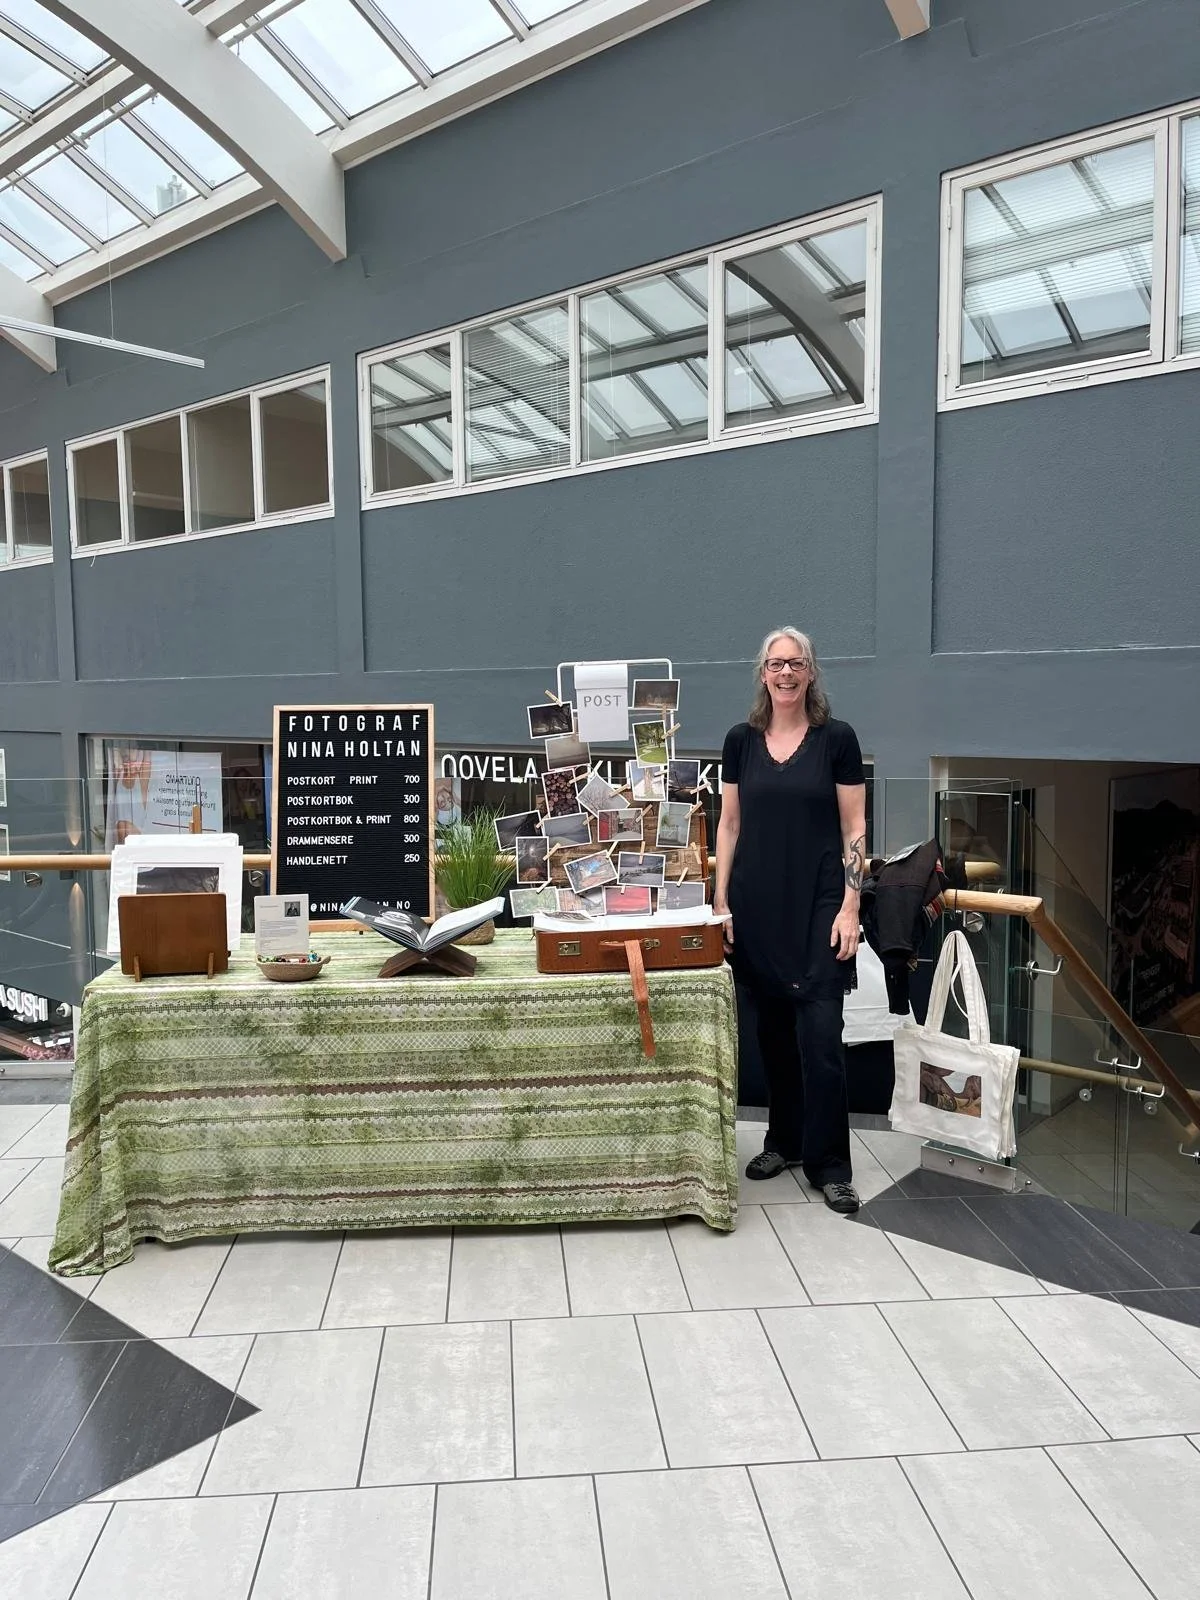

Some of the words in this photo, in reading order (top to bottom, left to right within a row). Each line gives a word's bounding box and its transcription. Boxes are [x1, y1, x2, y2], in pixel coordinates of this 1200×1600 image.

[583, 694, 622, 708] POST
[288, 714, 421, 732] FOTOGRAF
[287, 741, 335, 758] NINA
[344, 740, 421, 757] HOLTAN
[287, 776, 336, 785] POSTKORT
[349, 775, 378, 785] PRINT
[404, 775, 420, 784] 700
[287, 795, 354, 806] POSTKORTBOK
[403, 795, 420, 804] 300
[287, 815, 353, 826] POSTKORTBOK
[355, 815, 363, 825] &
[366, 814, 392, 824] PRINT
[403, 814, 420, 824] 800
[287, 835, 354, 845] DRAMMENSERE
[403, 834, 420, 843] 300
[286, 855, 348, 866] HANDLENETT
[404, 854, 420, 863] 250
